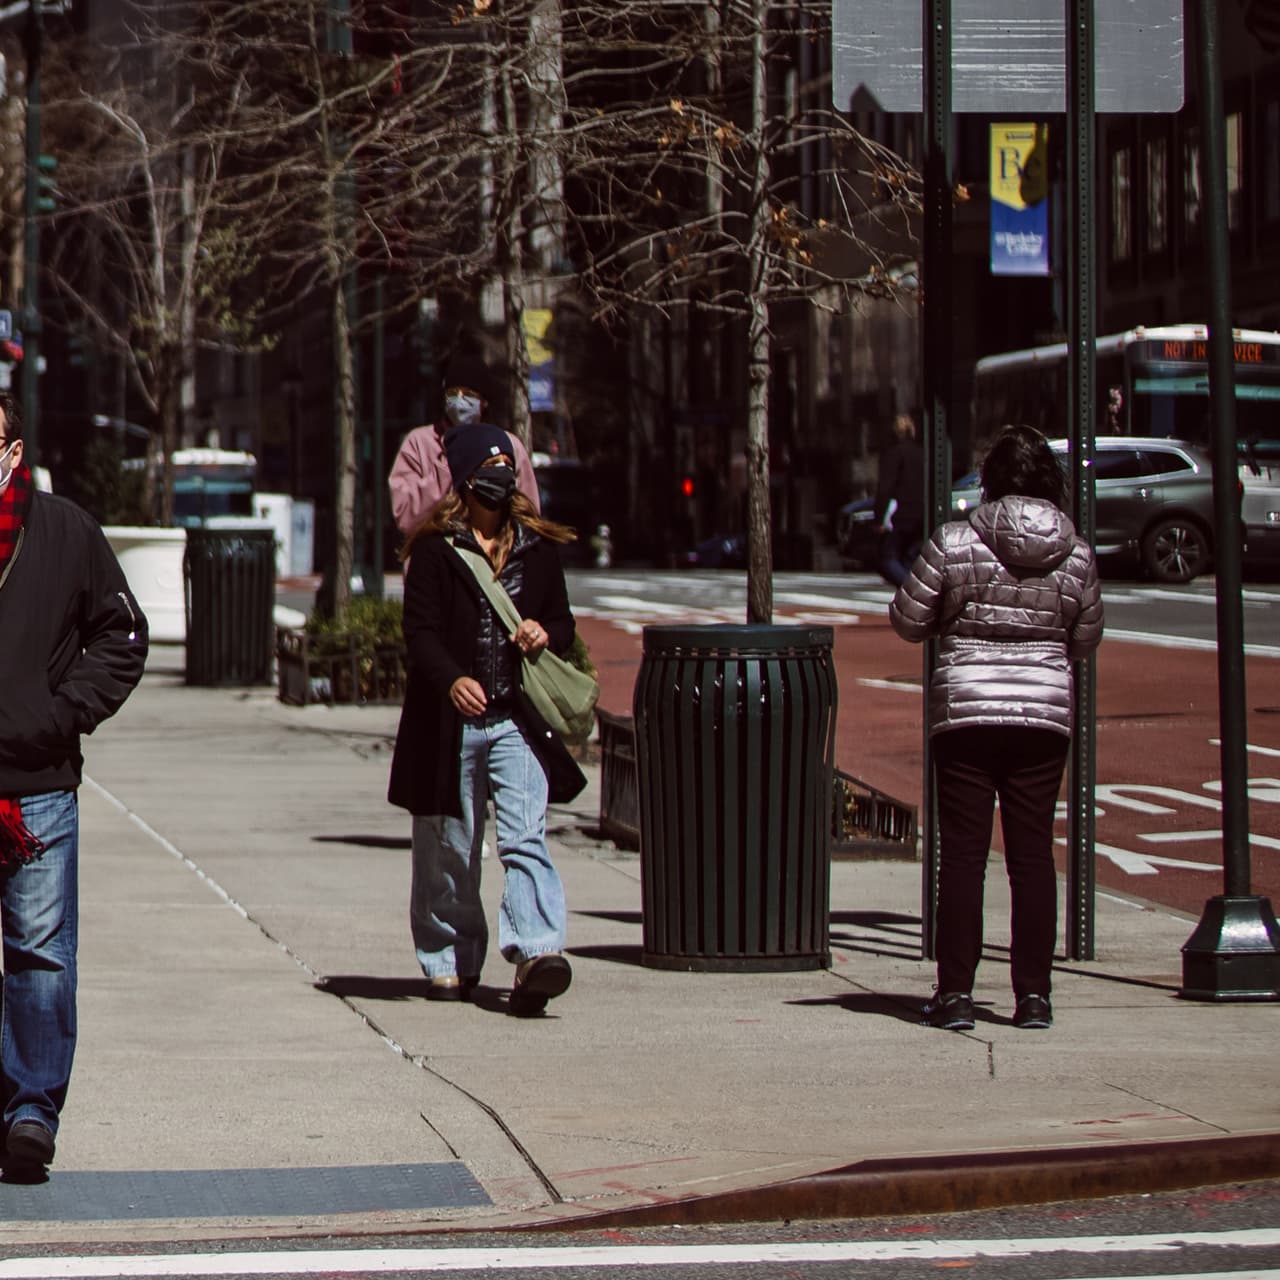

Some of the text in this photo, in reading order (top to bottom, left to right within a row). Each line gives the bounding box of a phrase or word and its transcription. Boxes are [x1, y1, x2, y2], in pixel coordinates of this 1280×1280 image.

[1165, 341, 1263, 363] NOT IN VICE
